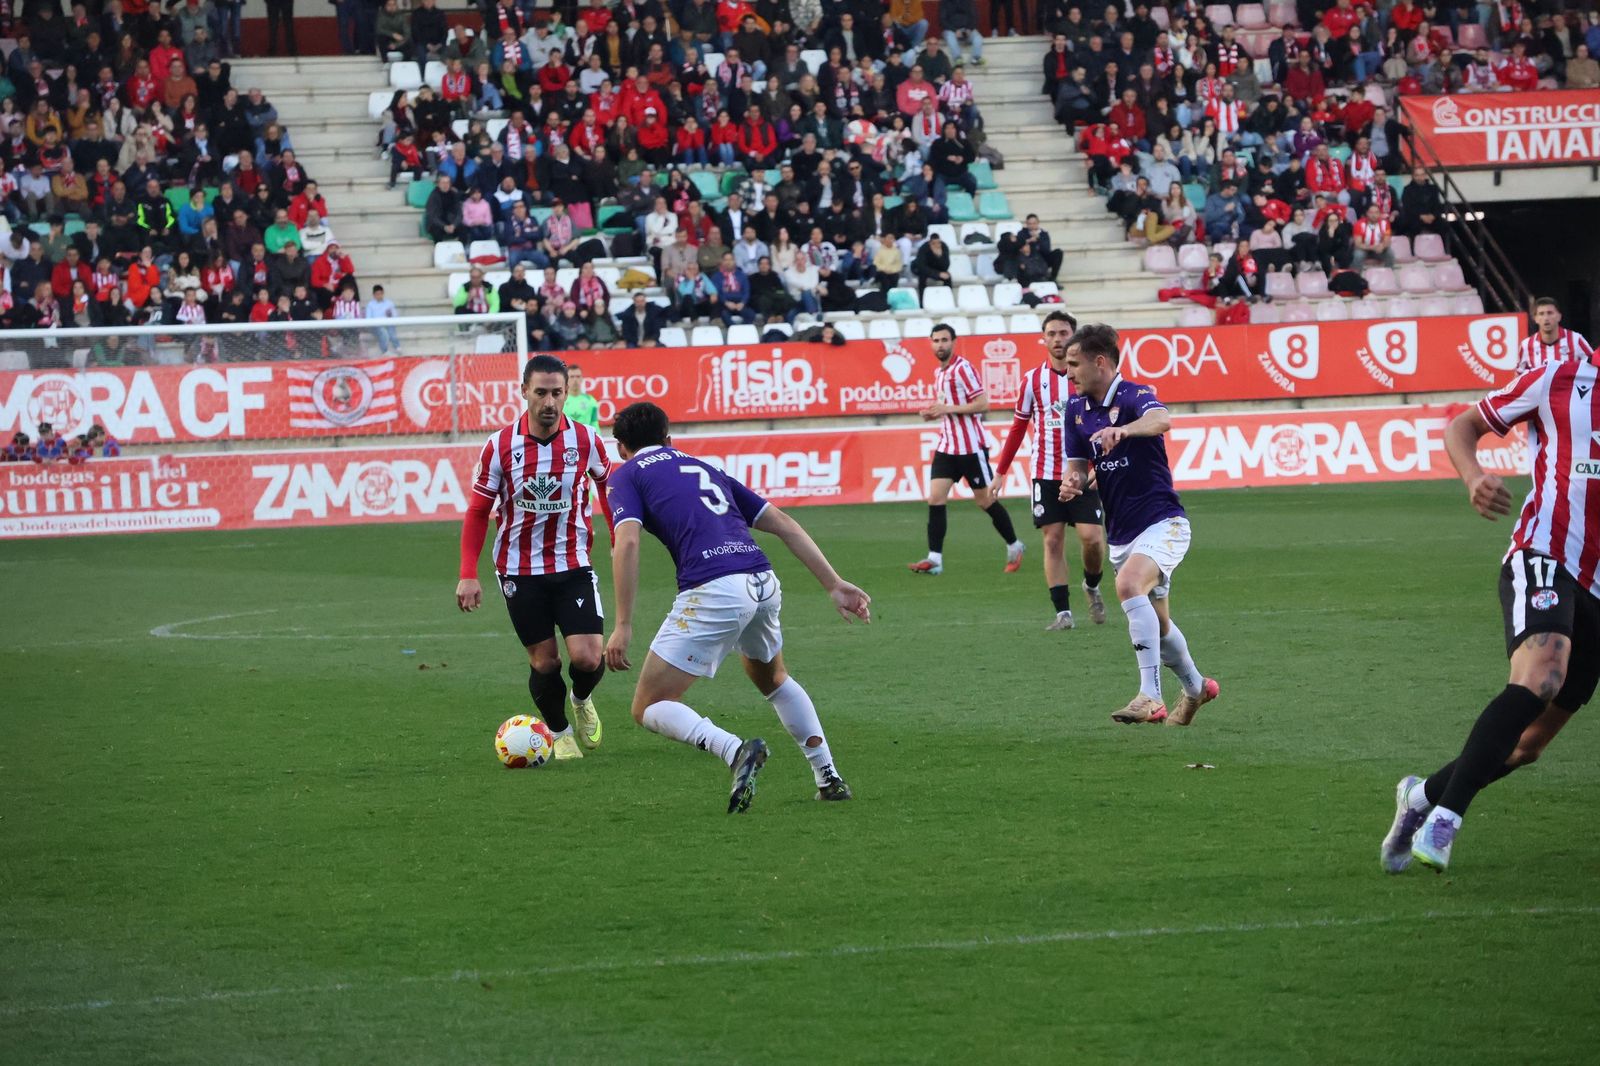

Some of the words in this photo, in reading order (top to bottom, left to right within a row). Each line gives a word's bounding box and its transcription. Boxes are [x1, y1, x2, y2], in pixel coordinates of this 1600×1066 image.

[1287, 334, 1308, 368] 8
[1386, 329, 1407, 364] 8
[1486, 325, 1508, 360] 8
[721, 347, 813, 391] fisio
[1257, 350, 1295, 393] ZAMORA
[1356, 347, 1394, 390] ZAMORA
[1457, 343, 1495, 385] ZAMORA
[178, 367, 273, 438] CF
[423, 380, 520, 407] CENTR
[580, 374, 669, 400] PTICO
[722, 377, 829, 411] readapt
[637, 452, 672, 469] AGUS
[1169, 421, 1379, 481] ZAMORA
[1378, 417, 1448, 474] CF
[9, 469, 95, 488] bodegas
[159, 463, 187, 479] del
[1575, 462, 1600, 474] CAJ
[252, 458, 469, 521] ZAMORA
[515, 500, 537, 511] CAJA
[538, 501, 569, 511] RURAL
[679, 465, 730, 516] 3
[1528, 556, 1558, 588] 17
